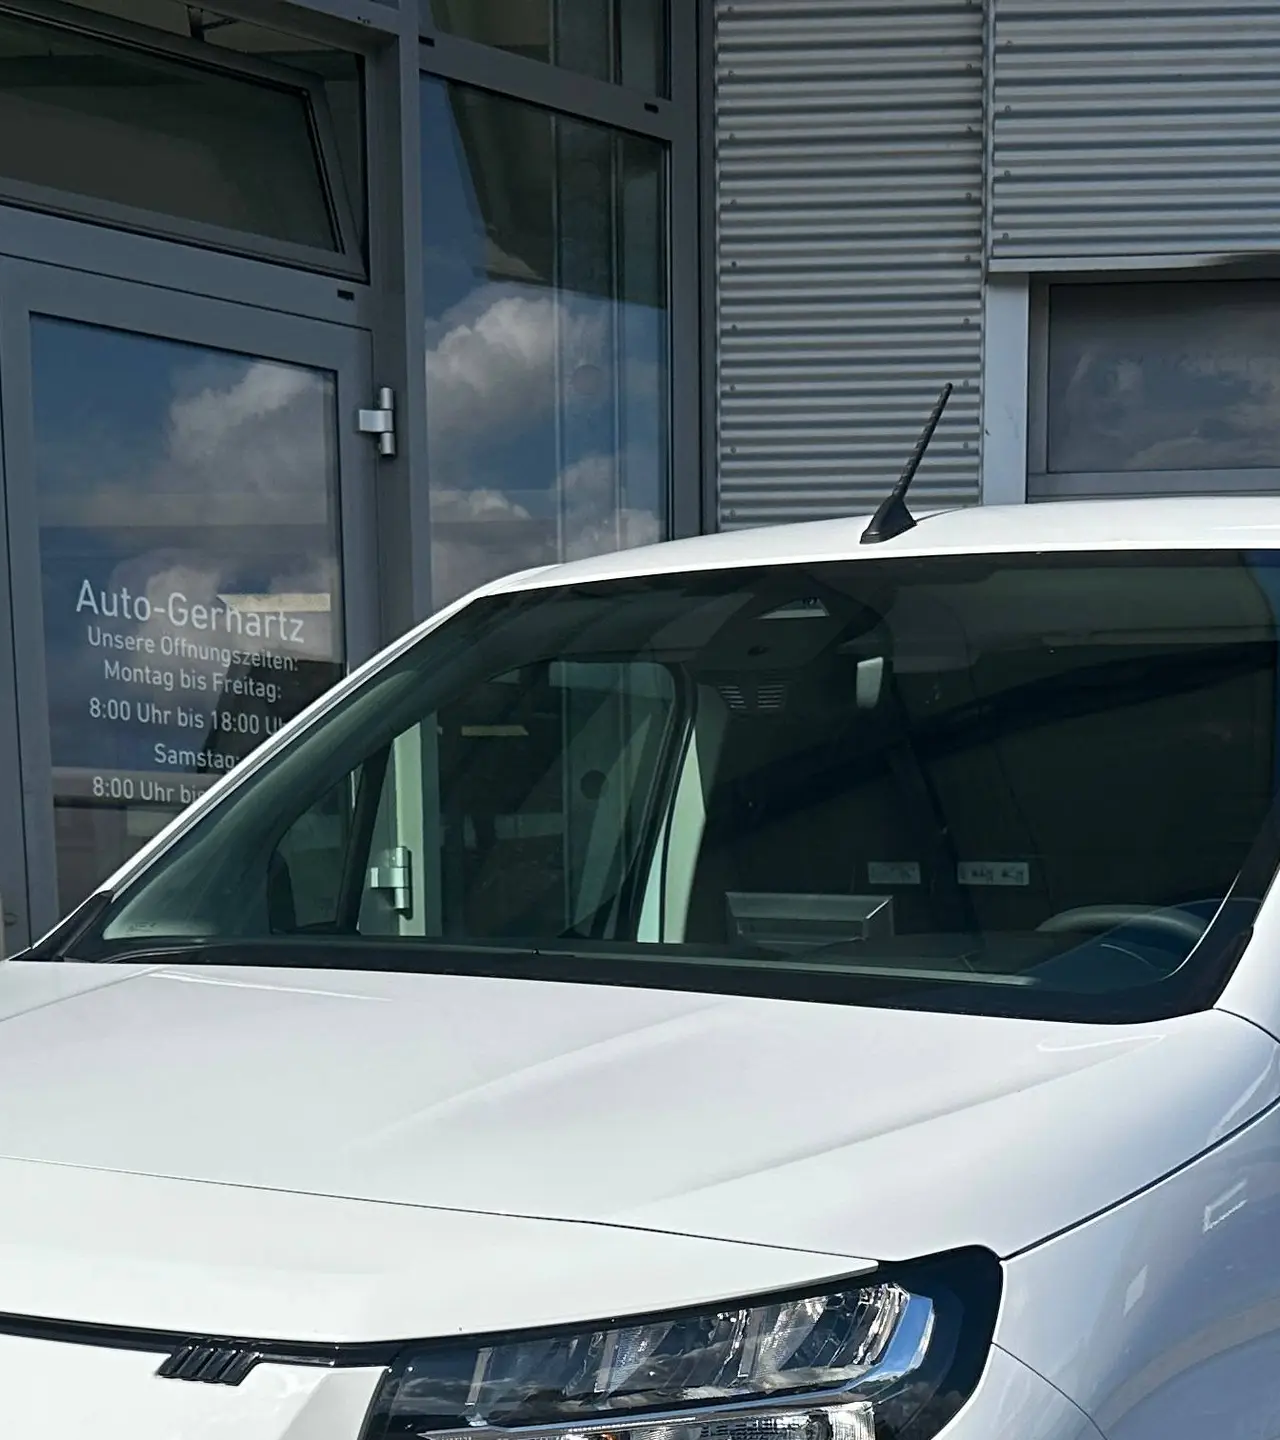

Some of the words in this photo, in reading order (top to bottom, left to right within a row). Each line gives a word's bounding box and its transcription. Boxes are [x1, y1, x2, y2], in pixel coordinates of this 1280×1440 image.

[76, 578, 305, 643] Auto-Gerhartz
[87, 625, 156, 653] Unsere
[160, 631, 299, 672] Öffnungszeiten:
[104, 659, 174, 691] Montag
[180, 668, 207, 691] bis
[213, 671, 282, 702] Freitag:
[89, 697, 131, 720] 8:00
[137, 703, 172, 725] Uhr
[178, 706, 205, 729] bis
[211, 711, 260, 734] 18:00
[92, 776, 134, 799] 8:00
[140, 781, 175, 801] Uhr
